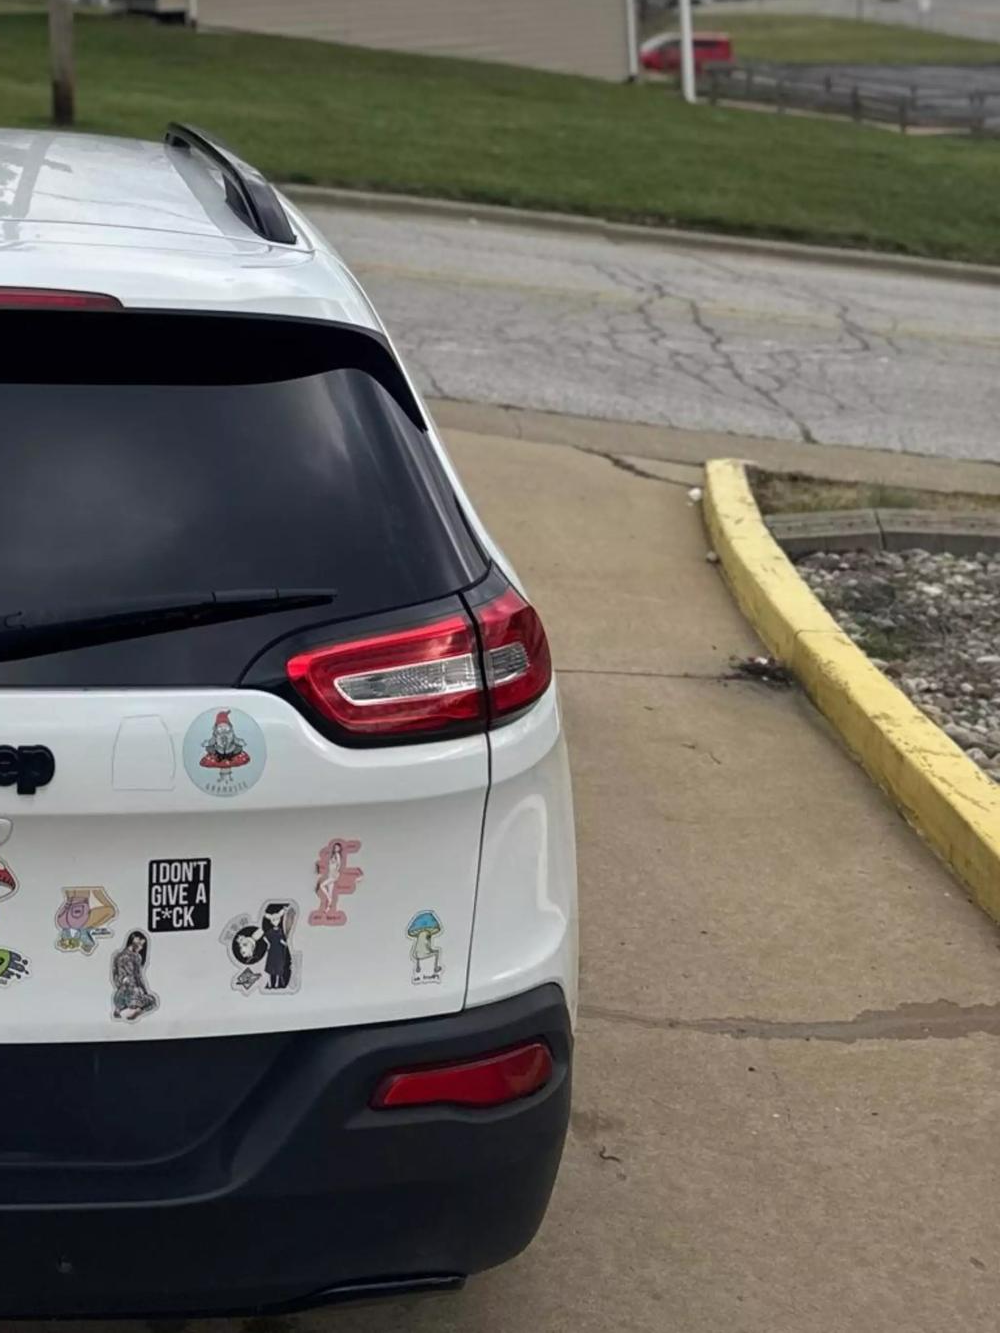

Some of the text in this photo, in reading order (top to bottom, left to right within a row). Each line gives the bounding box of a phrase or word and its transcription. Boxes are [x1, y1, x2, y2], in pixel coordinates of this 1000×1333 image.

[152, 861, 207, 883] I DON'T
[151, 882, 207, 906] GIVE A
